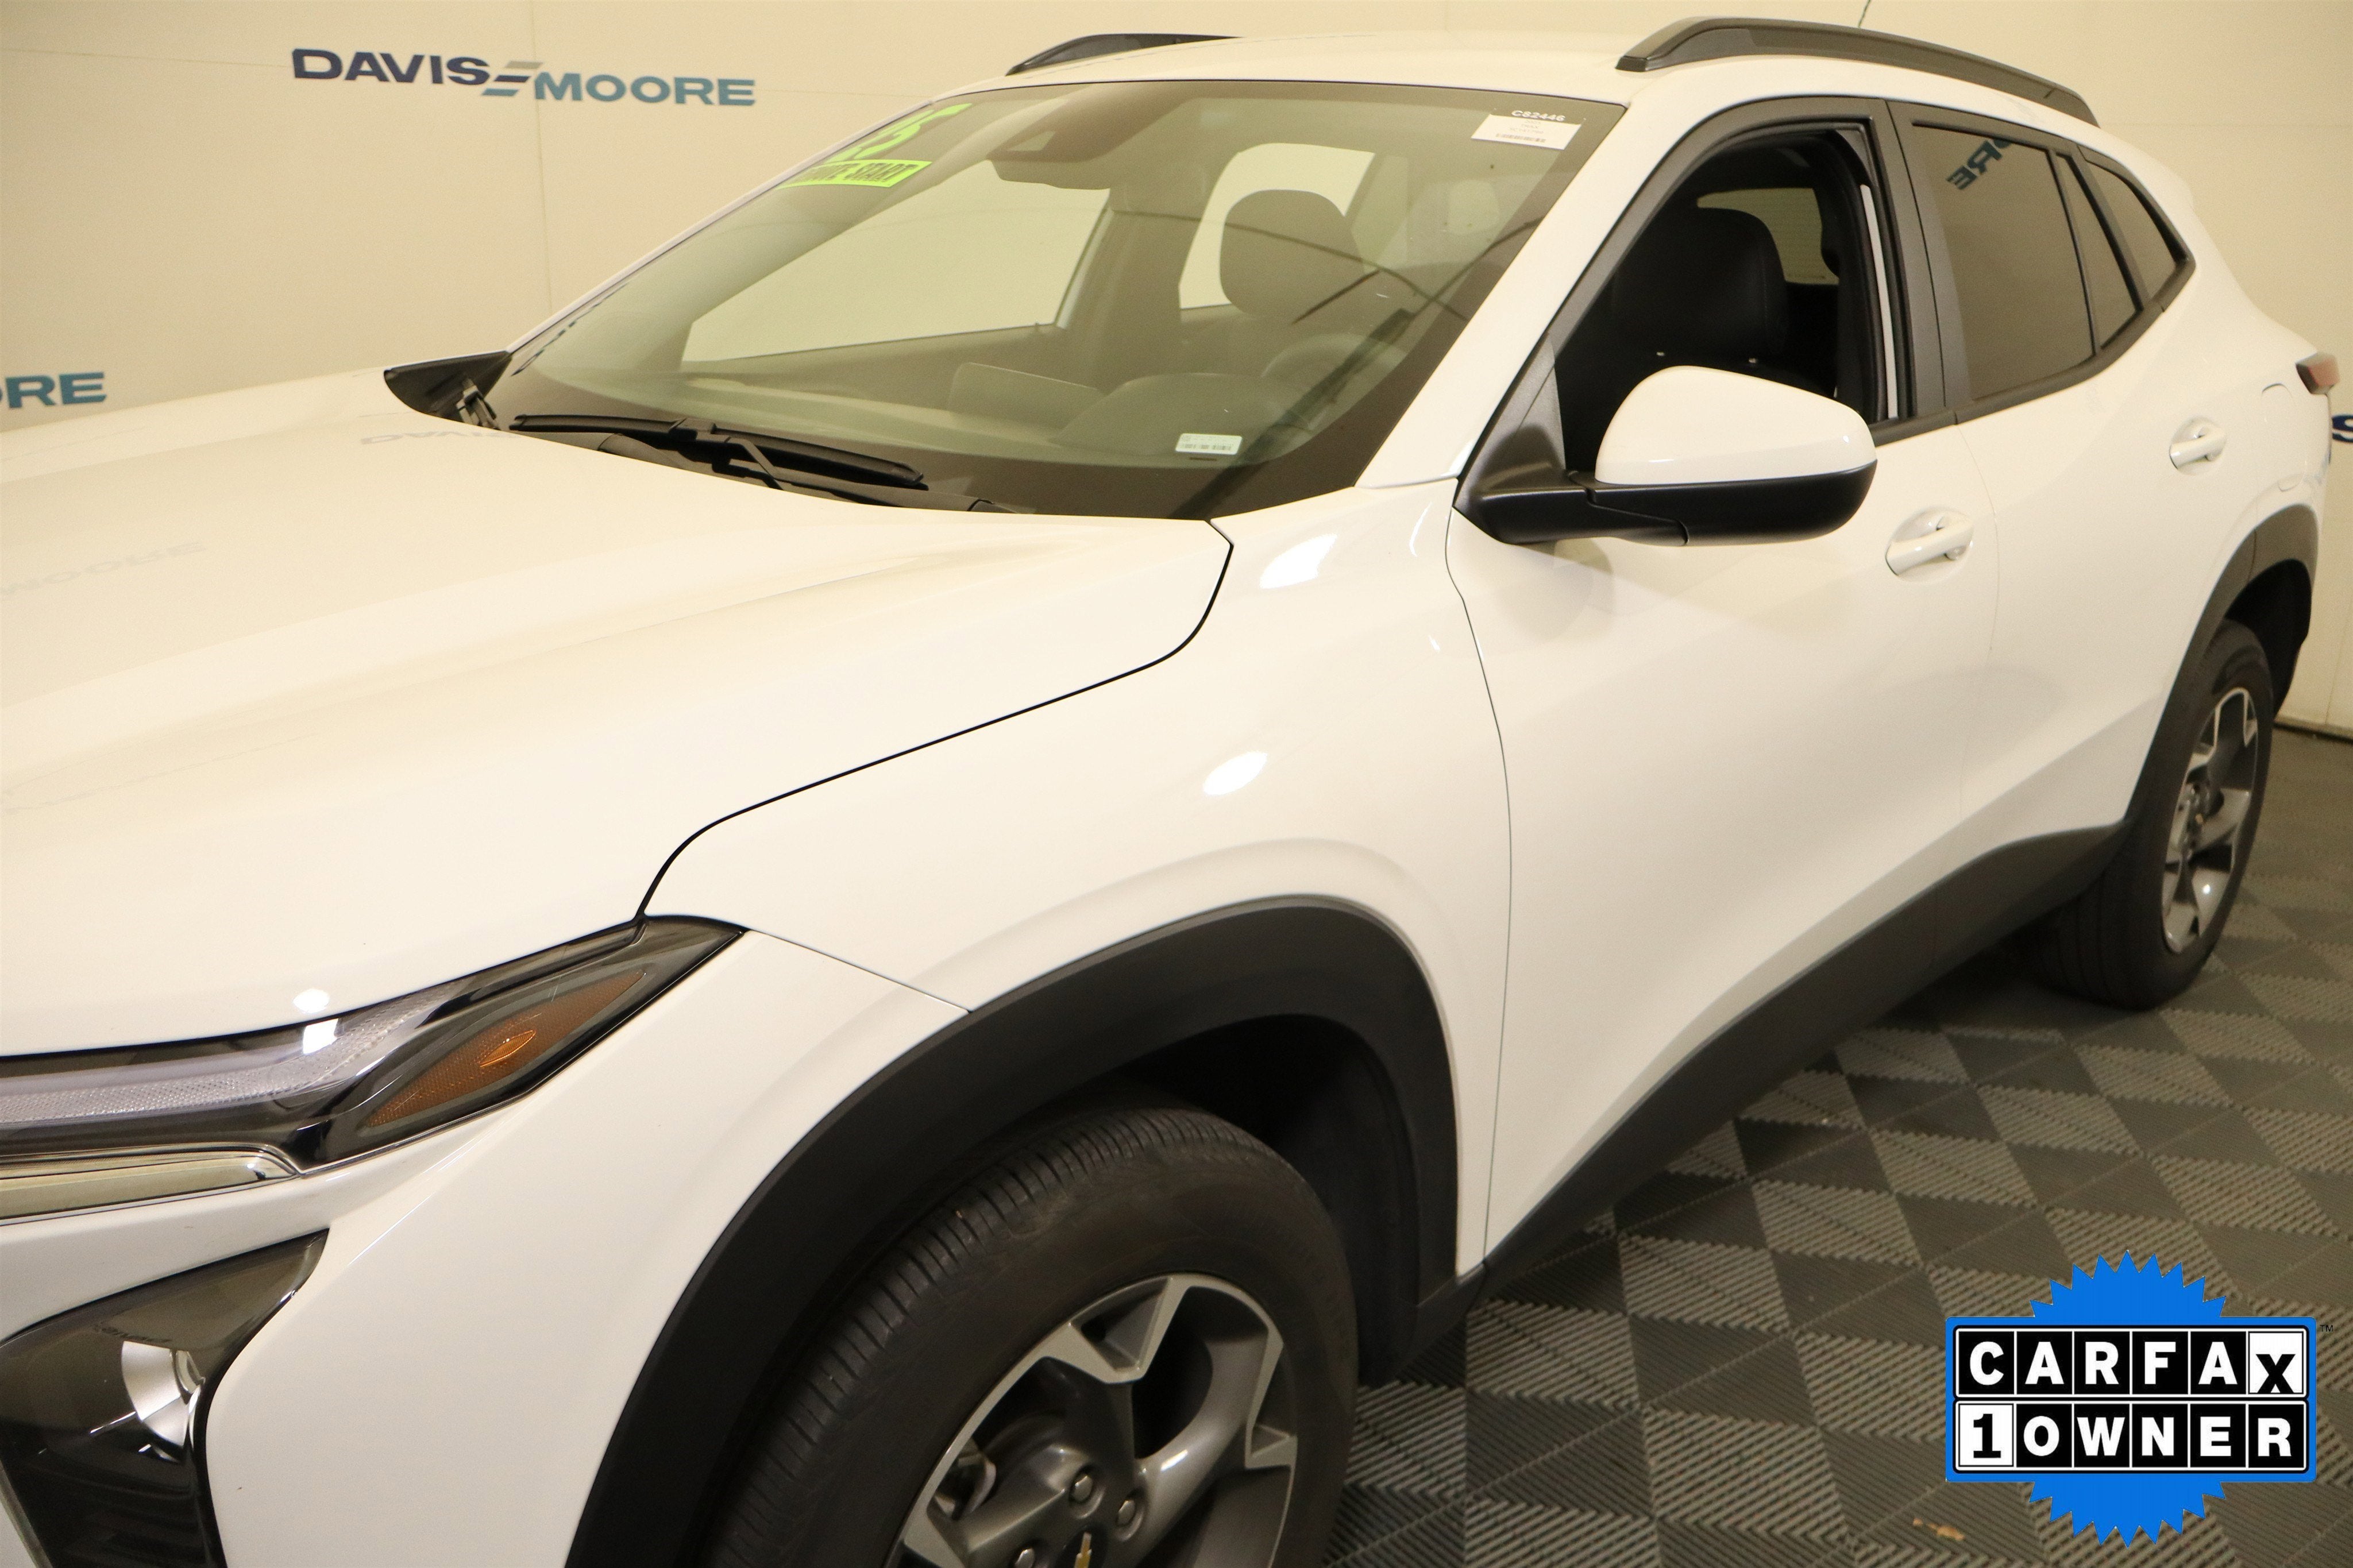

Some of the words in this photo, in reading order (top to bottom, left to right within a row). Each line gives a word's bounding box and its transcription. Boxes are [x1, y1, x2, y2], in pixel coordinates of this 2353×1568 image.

[292, 48, 489, 86] DAVIS
[533, 72, 756, 106] MOORE
[0, 372, 107, 408] RE
